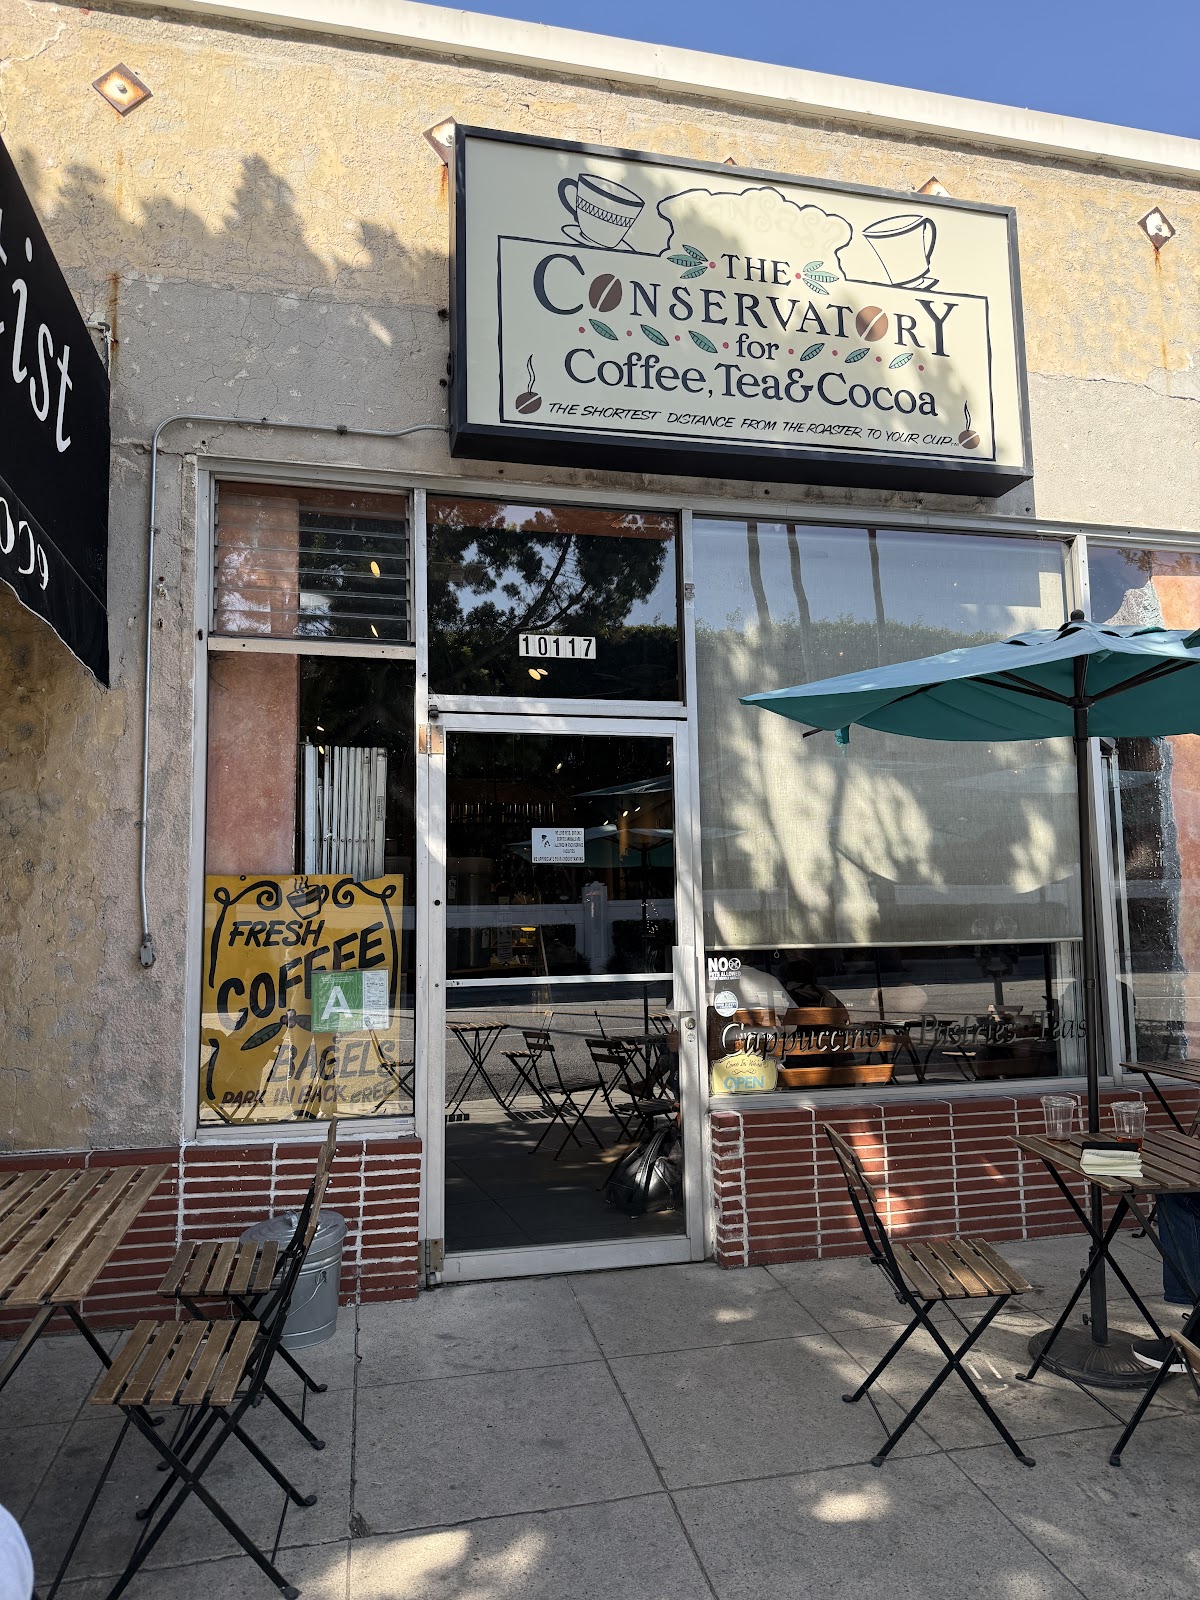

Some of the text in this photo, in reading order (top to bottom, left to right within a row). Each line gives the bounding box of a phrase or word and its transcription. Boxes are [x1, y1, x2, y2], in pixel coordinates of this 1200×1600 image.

[720, 253, 792, 287] THE
[735, 332, 780, 361] for
[549, 402, 581, 415] THE
[580, 405, 662, 421] SHORTEST
[666, 412, 736, 428] DISTANCE
[740, 418, 778, 431] FROM
[782, 421, 806, 433] THE
[806, 423, 863, 438] ROASTER
[867, 428, 883, 440] TO
[885, 430, 921, 444] YOUR
[522, 635, 593, 657] 10117
[228, 919, 326, 948] FRESH
[216, 921, 386, 1031] COFFEE
[708, 957, 729, 972] NO
[320, 985, 354, 1020] A
[719, 1021, 884, 1062] Cappuccino
[270, 1039, 397, 1084] BAGELS
[221, 1090, 265, 1106] PARK
[300, 1083, 348, 1105] BACK
[723, 1075, 765, 1090] OPEN
